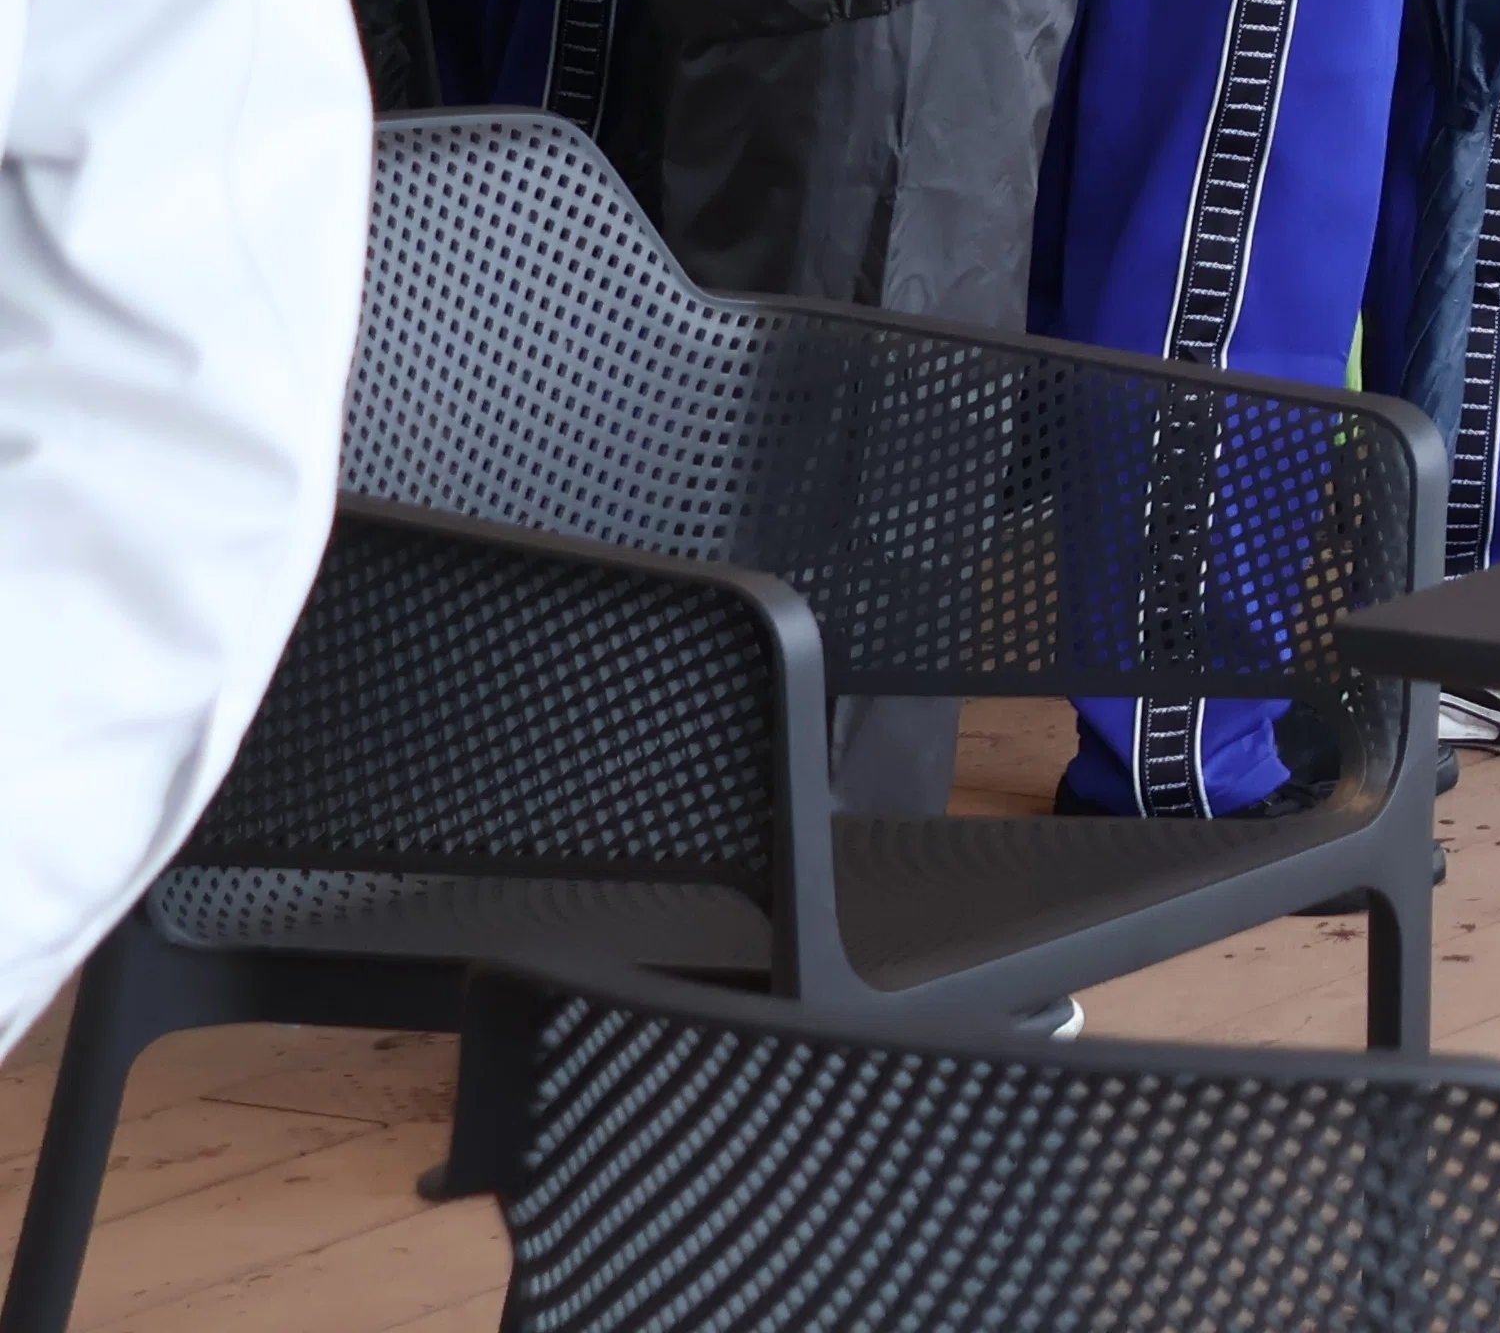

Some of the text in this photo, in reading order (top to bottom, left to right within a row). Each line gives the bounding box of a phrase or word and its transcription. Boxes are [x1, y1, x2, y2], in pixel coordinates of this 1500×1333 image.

[1241, 23, 1280, 32] reebok
[1236, 50, 1276, 59] reebok
[1230, 76, 1271, 85] reebok
[1225, 103, 1265, 111] reebok
[1218, 127, 1260, 138] reebok
[1213, 151, 1254, 163] reebok
[1207, 178, 1249, 189] reebok
[1202, 205, 1243, 216] reebok
[1198, 232, 1239, 243] reebok
[1193, 260, 1235, 270] reebok
[1188, 287, 1230, 297] reebok
[1184, 313, 1225, 323] reebok
[1177, 339, 1217, 348] reebok
